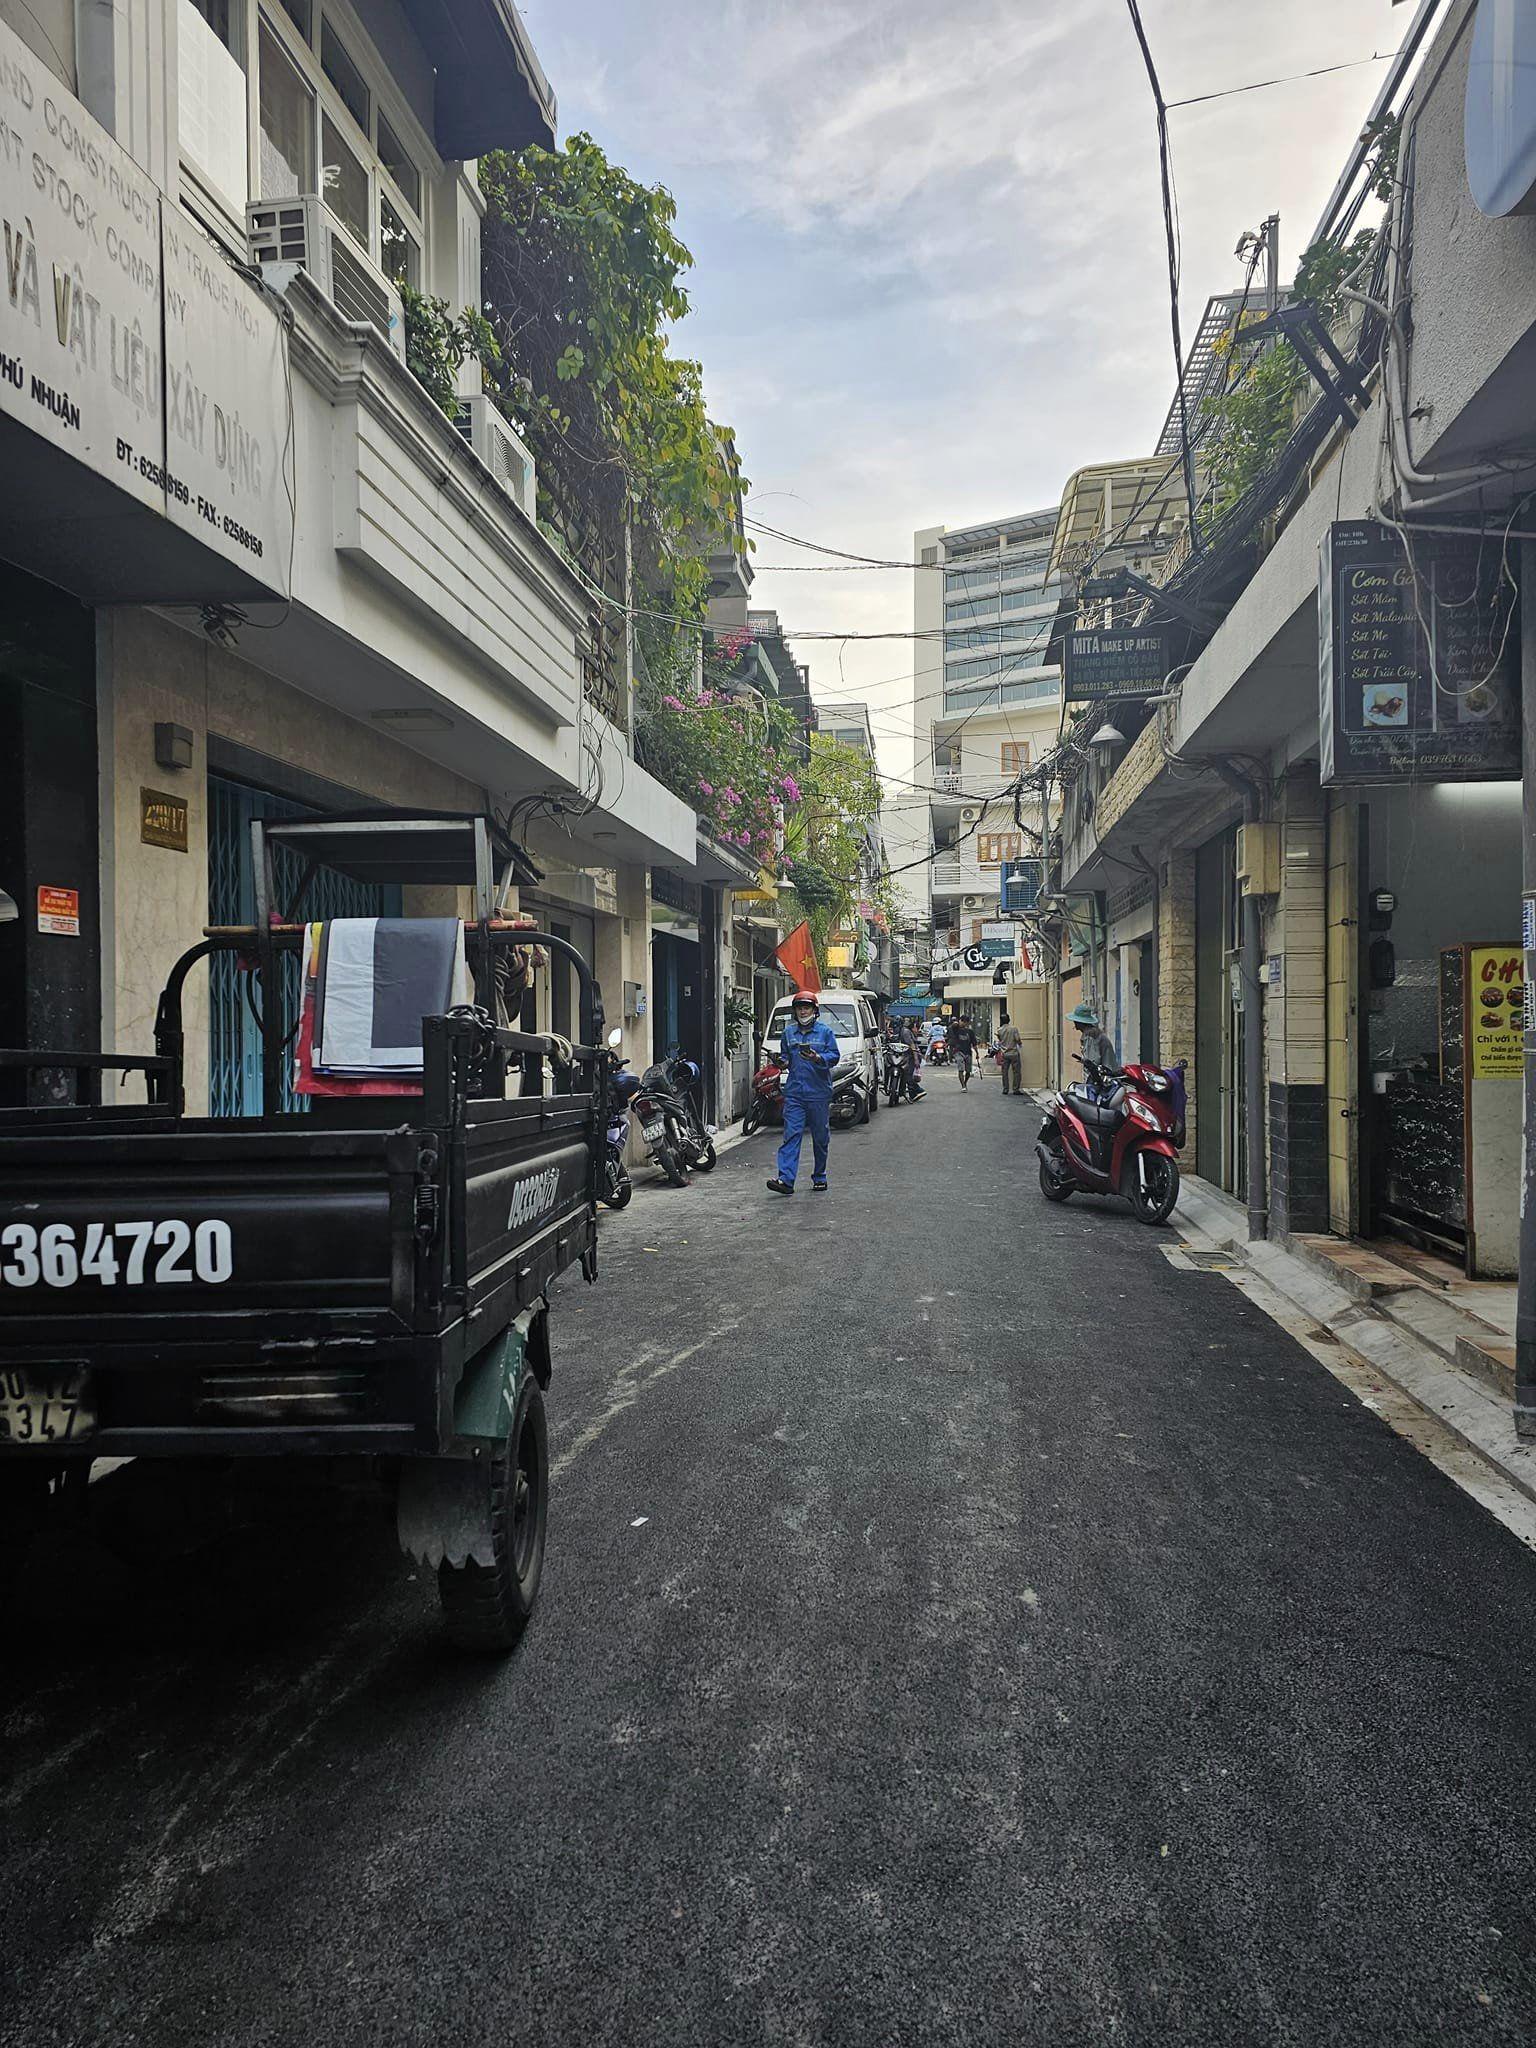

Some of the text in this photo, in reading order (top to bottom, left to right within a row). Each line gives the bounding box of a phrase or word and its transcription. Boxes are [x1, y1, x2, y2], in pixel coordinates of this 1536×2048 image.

[0, 52, 33, 111] ND
[44, 97, 180, 264] CONSTRUCTIN
[32, 151, 99, 247] STOCK
[3, 215, 41, 328] VÀ
[52, 260, 101, 376] VẬT
[168, 360, 208, 456] XÂY
[31, 374, 80, 432] NHUẬN
[1073, 636, 1161, 655] MITA MAKE UP ARTIST
[1, 1219, 233, 1288] 364720
